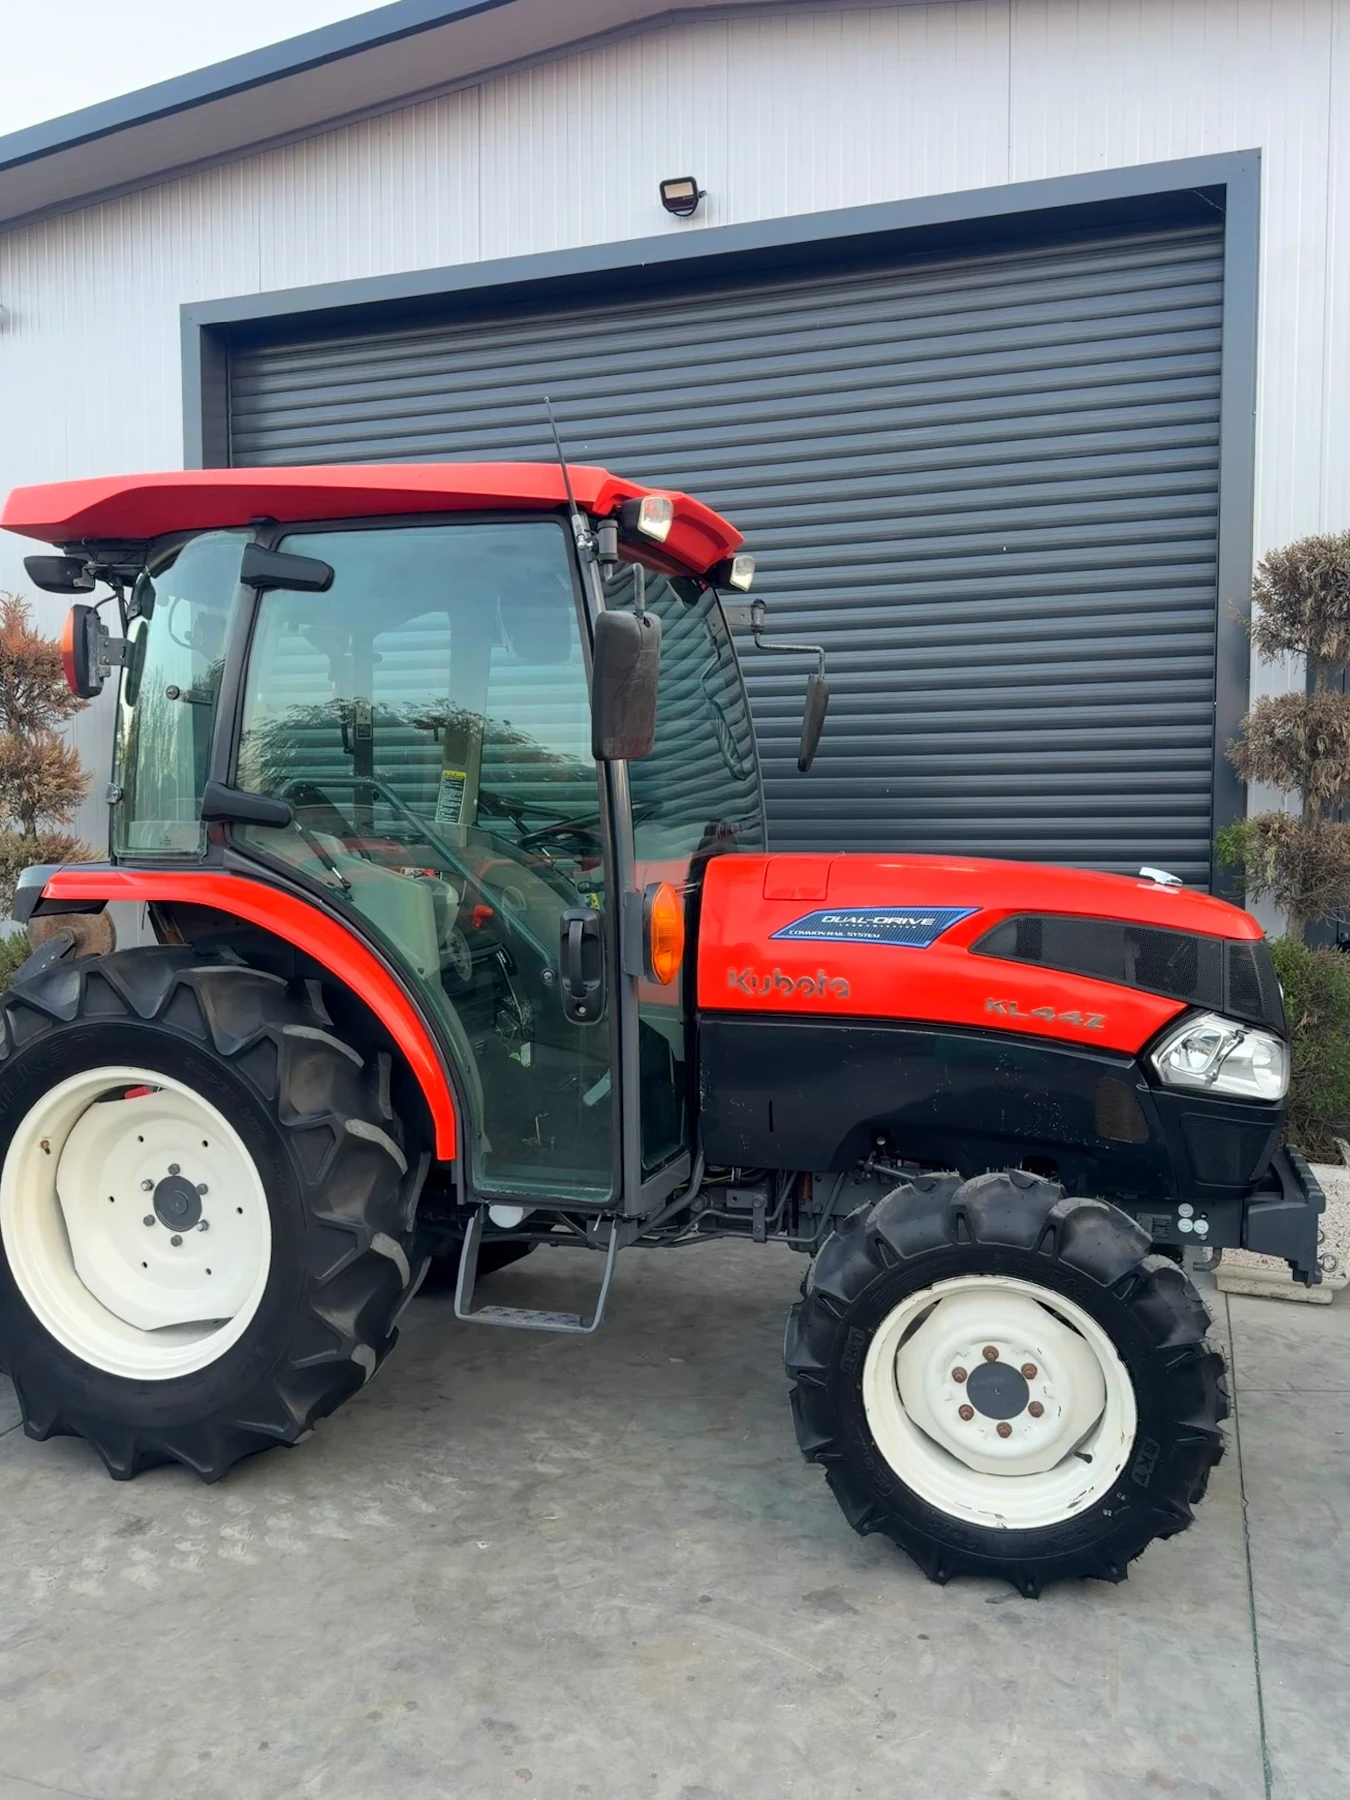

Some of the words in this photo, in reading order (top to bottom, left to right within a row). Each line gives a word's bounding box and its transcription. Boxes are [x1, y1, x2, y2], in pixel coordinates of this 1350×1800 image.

[821, 915, 936, 926] DUAL-DRIVE
[728, 966, 850, 998] Kubota
[986, 998, 1106, 1029] KL44Z
